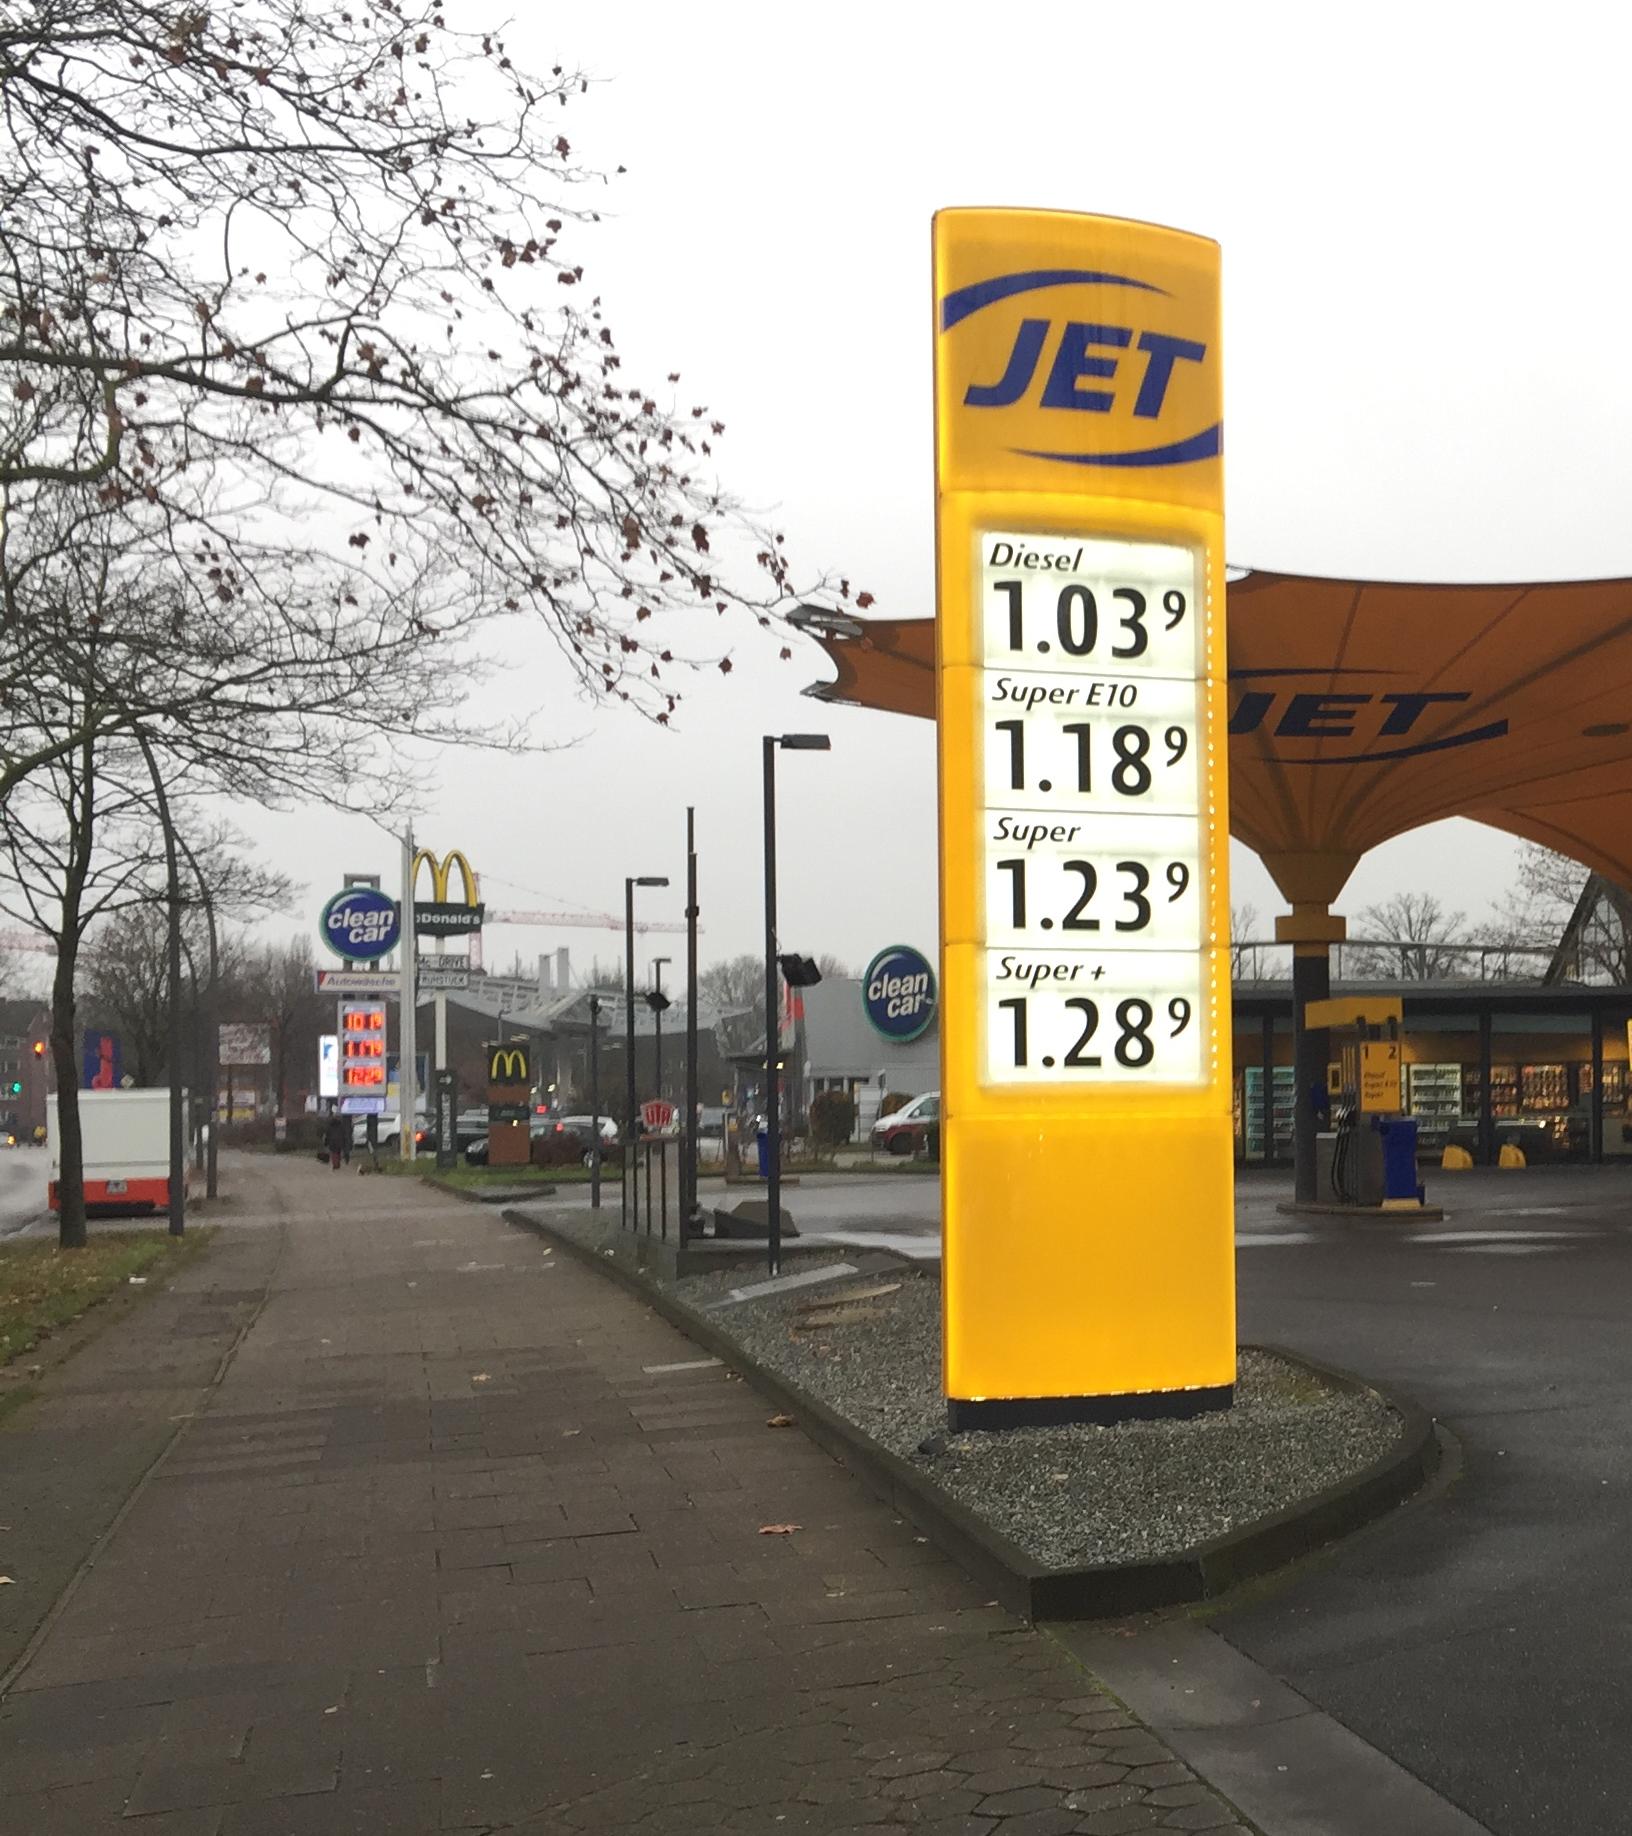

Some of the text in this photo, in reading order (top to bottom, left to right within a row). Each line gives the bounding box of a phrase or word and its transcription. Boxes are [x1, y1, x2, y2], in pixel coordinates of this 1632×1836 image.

[963, 318, 1207, 420] JET
[989, 543, 1083, 572] Diesel
[991, 677, 1138, 712] Super E10
[993, 817, 1081, 850] Super
[328, 908, 394, 929] clean
[416, 912, 480, 924] Donald's
[348, 926, 392, 943] car
[868, 972, 928, 1001] clean
[996, 956, 1083, 989] Super
[887, 993, 925, 1018] car
[1361, 1046, 1397, 1060] 1 2
